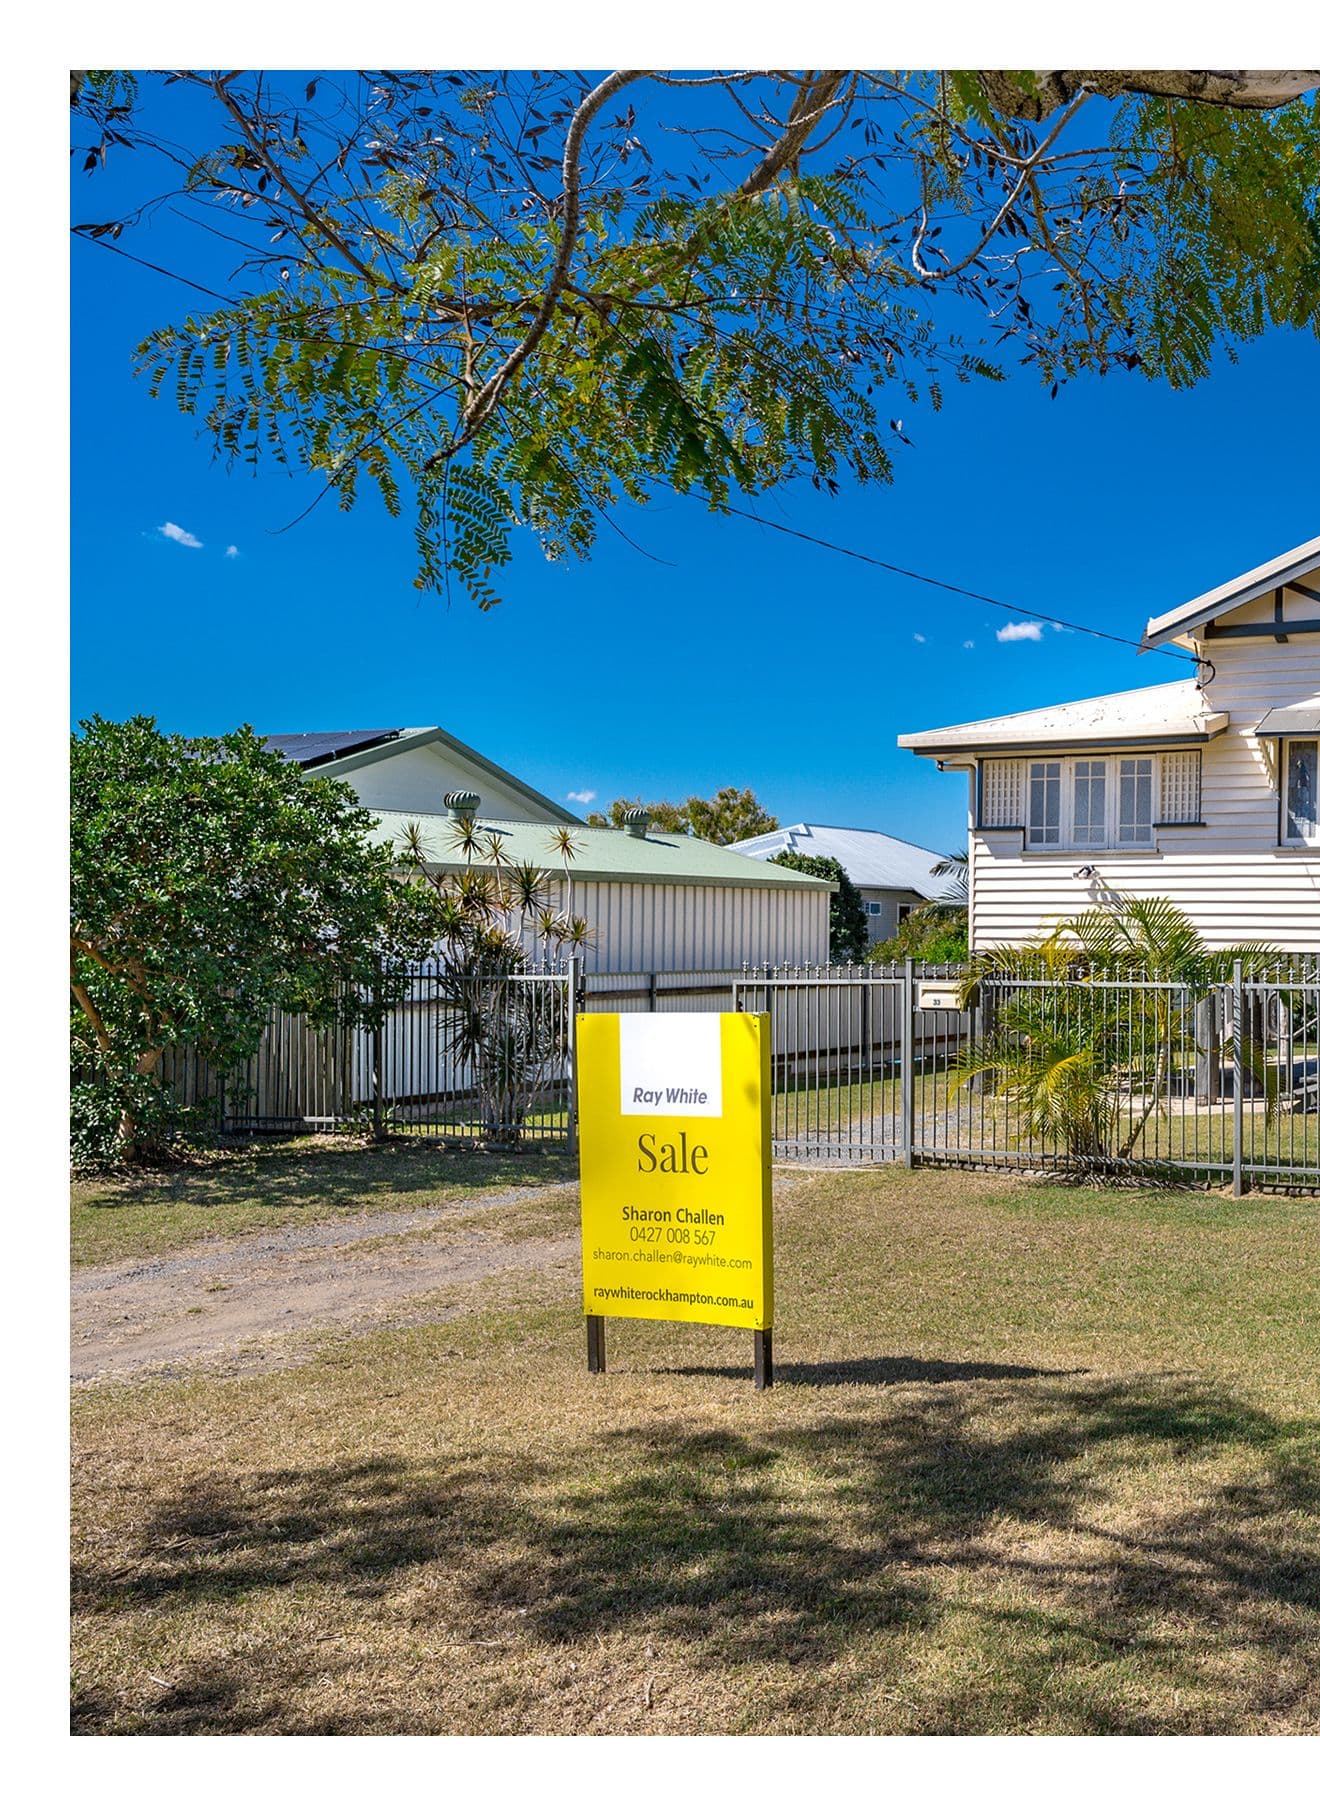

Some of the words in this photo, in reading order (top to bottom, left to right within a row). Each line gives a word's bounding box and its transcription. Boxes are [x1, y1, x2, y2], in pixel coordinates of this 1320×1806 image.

[633, 1087, 663, 1106] Ray
[666, 1087, 708, 1104] White
[638, 1132, 709, 1175] Sale
[622, 1206, 672, 1223] Sharon
[675, 1208, 725, 1226] Challen
[630, 1226, 662, 1243] 0427
[666, 1228, 690, 1244] 008
[694, 1230, 716, 1246] 567
[592, 1247, 753, 1270] sharon.challen@raywhite.com
[593, 1286, 754, 1309] raywhiterockhampton.com.au
